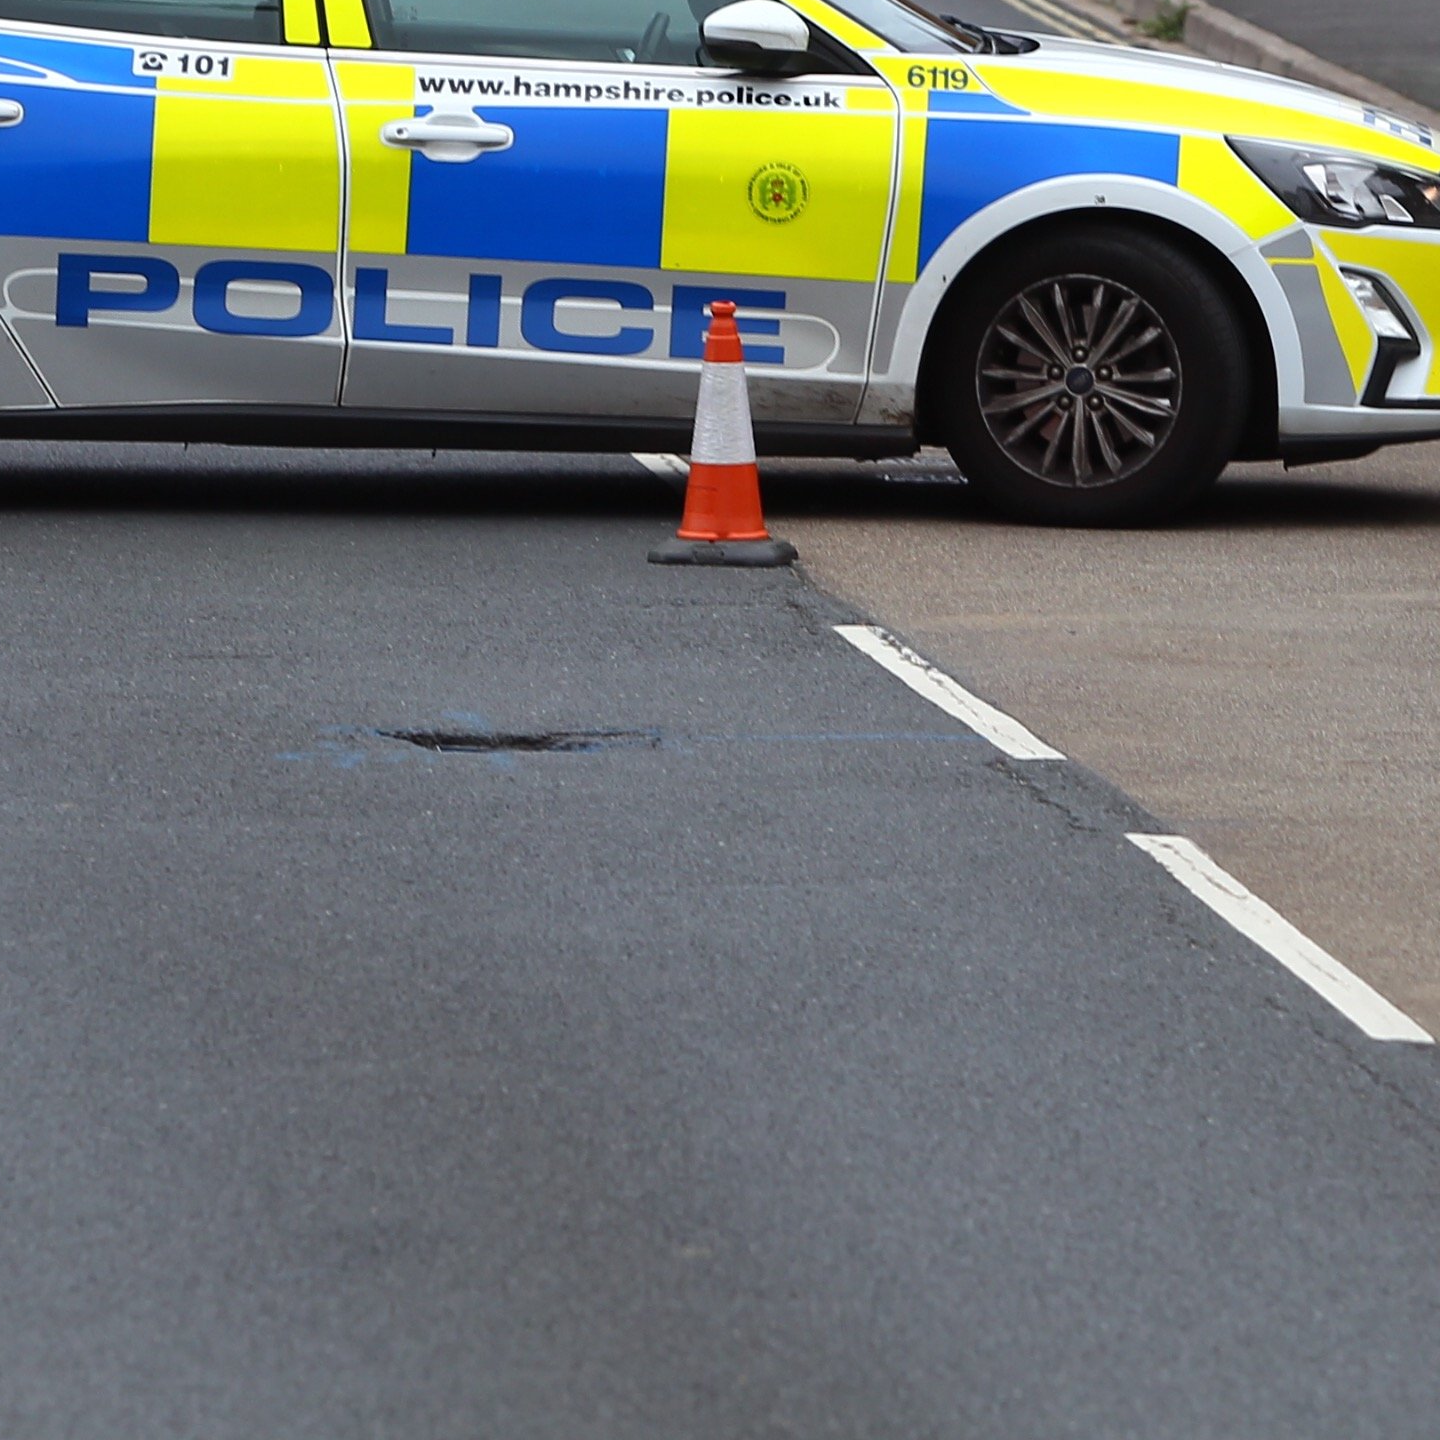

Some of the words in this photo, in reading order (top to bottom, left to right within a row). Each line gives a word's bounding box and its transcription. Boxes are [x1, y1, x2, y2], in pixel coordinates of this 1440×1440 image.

[178, 53, 230, 77] 101
[907, 64, 969, 90] 6119
[418, 74, 842, 110] www.hampshire.police.uk
[56, 253, 786, 364] POLICE
